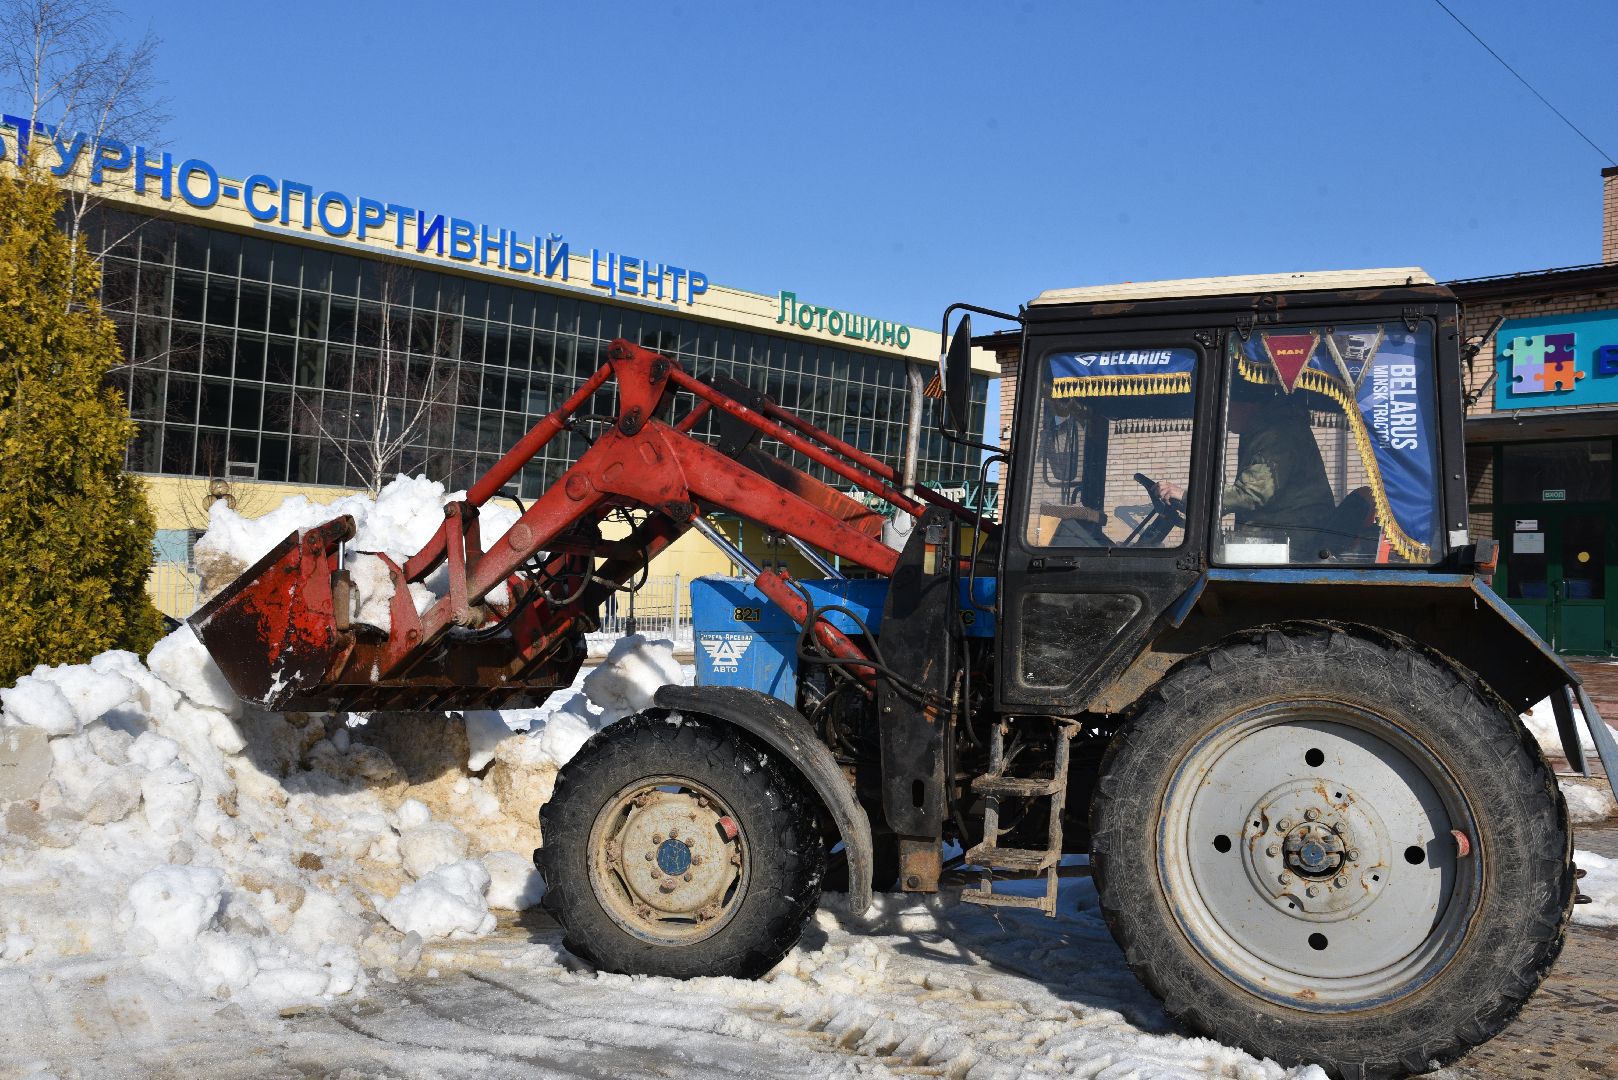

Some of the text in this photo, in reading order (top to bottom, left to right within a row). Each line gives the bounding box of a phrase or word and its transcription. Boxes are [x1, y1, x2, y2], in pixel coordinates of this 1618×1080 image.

[0, 113, 709, 306] ТУРНО-СПОРТИВНЫЙ ЦЕНТР
[1099, 350, 1172, 366] BELARUS
[1276, 348, 1304, 356] MAN
[1373, 365, 1391, 449] MINSK TRACTOR
[1389, 364, 1418, 450] BELARUS
